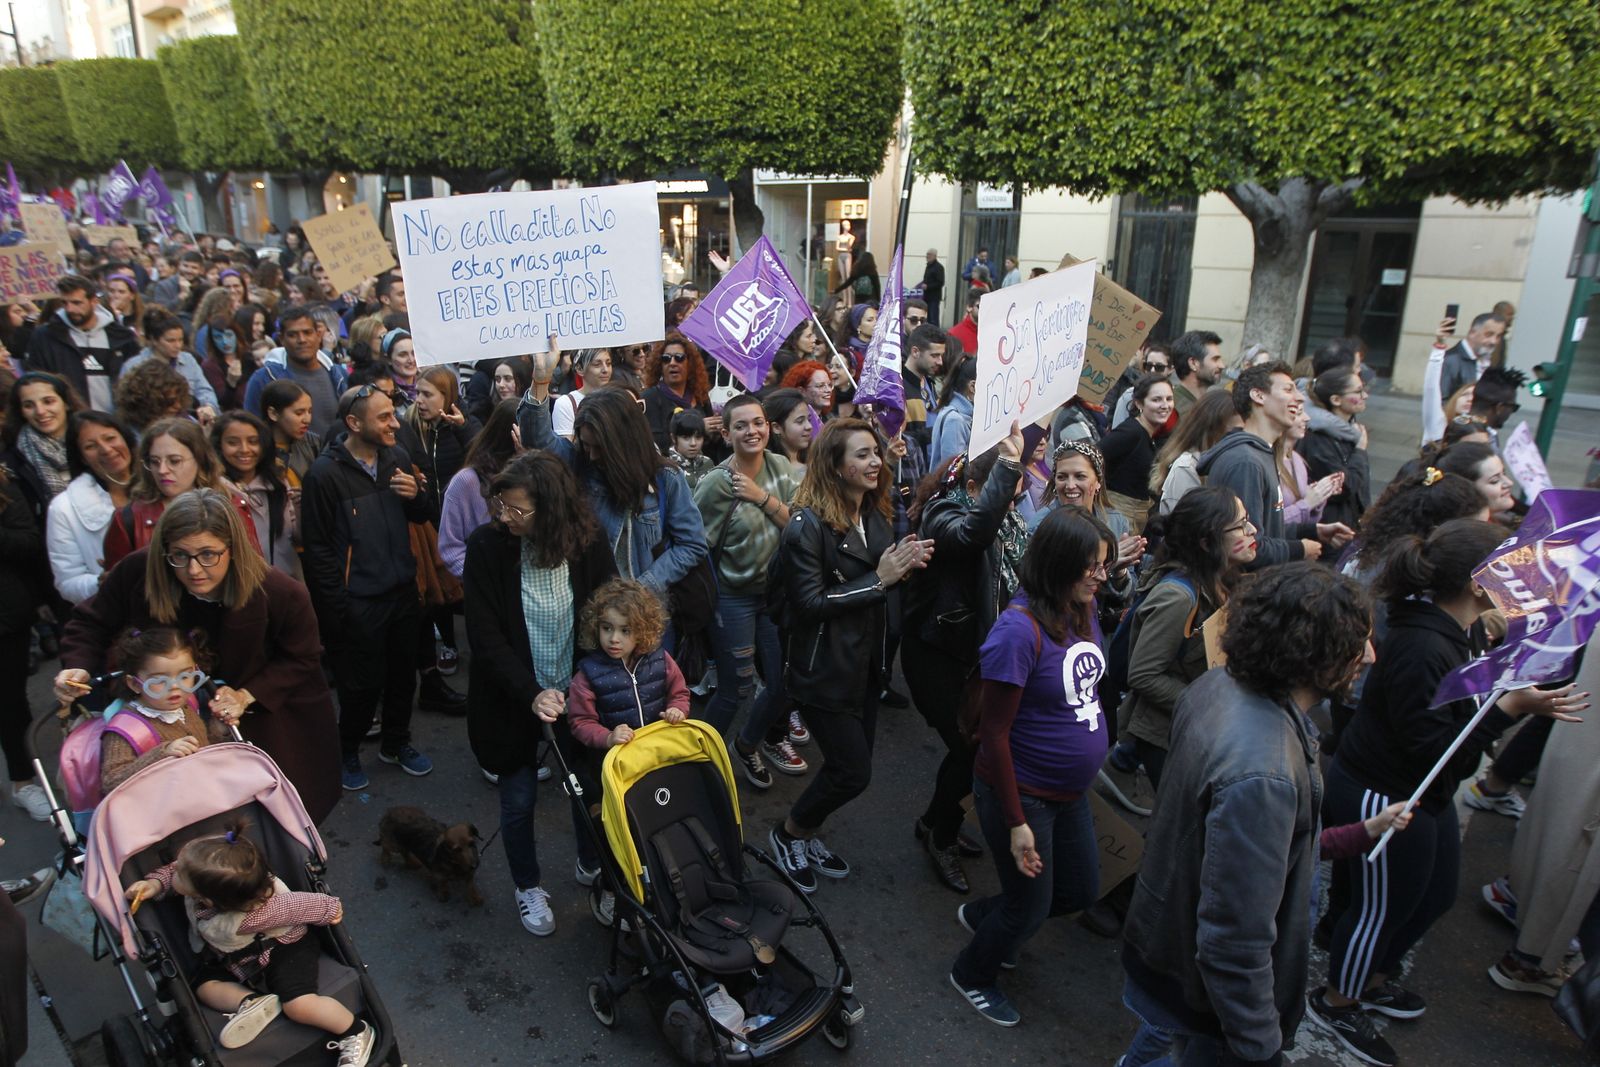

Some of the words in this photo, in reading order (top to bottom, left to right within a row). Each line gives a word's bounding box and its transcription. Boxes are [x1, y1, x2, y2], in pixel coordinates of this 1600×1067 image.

[461, 205, 579, 250] calladita
[580, 195, 616, 233] No
[15, 251, 48, 270] LAS
[552, 244, 608, 277] guapa
[437, 283, 502, 321] ERES
[719, 282, 772, 343] UGT
[478, 316, 540, 345] cuando
[545, 303, 627, 340] LUCHAS
[998, 302, 1031, 365] Sin
